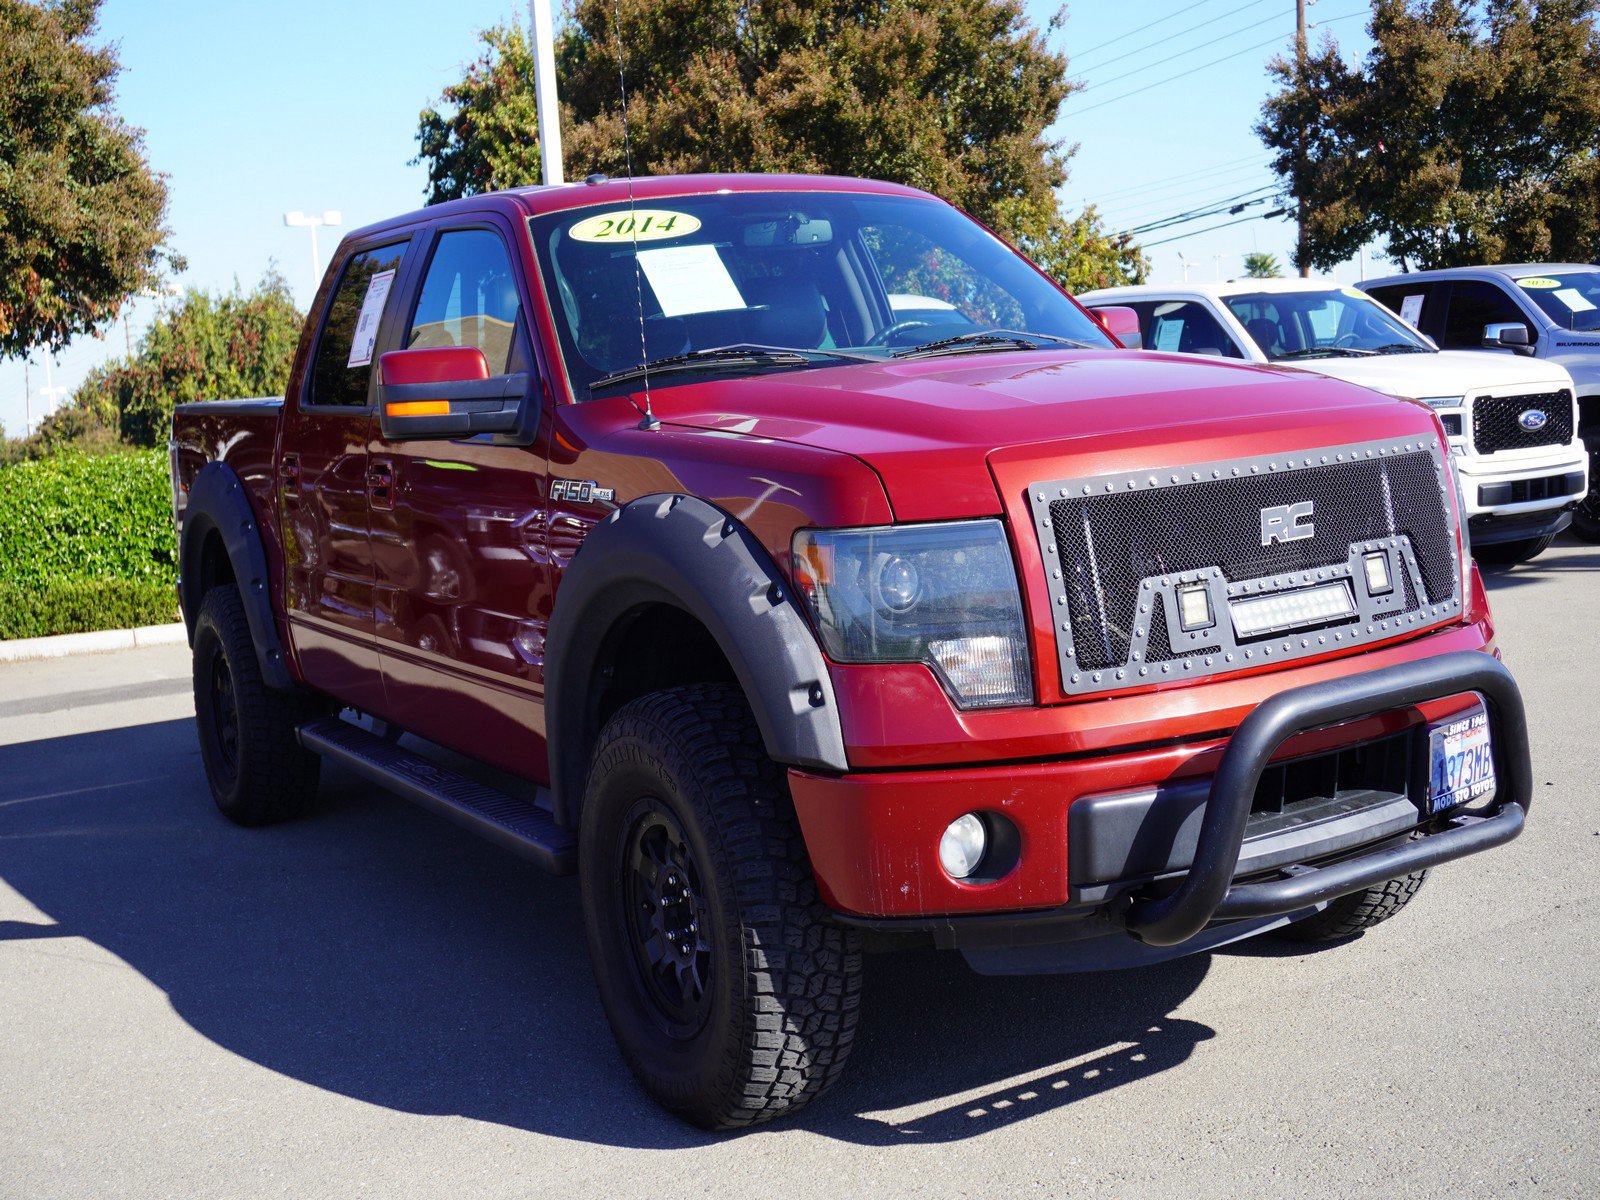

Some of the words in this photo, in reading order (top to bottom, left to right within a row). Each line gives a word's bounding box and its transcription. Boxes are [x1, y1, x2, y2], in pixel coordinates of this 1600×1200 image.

[594, 215, 677, 237] 2014
[1261, 501, 1314, 545] RC
[1450, 719, 1470, 735] SINCE
[1433, 788, 1469, 811] MODESTO
[1471, 778, 1495, 796] TOYOT
